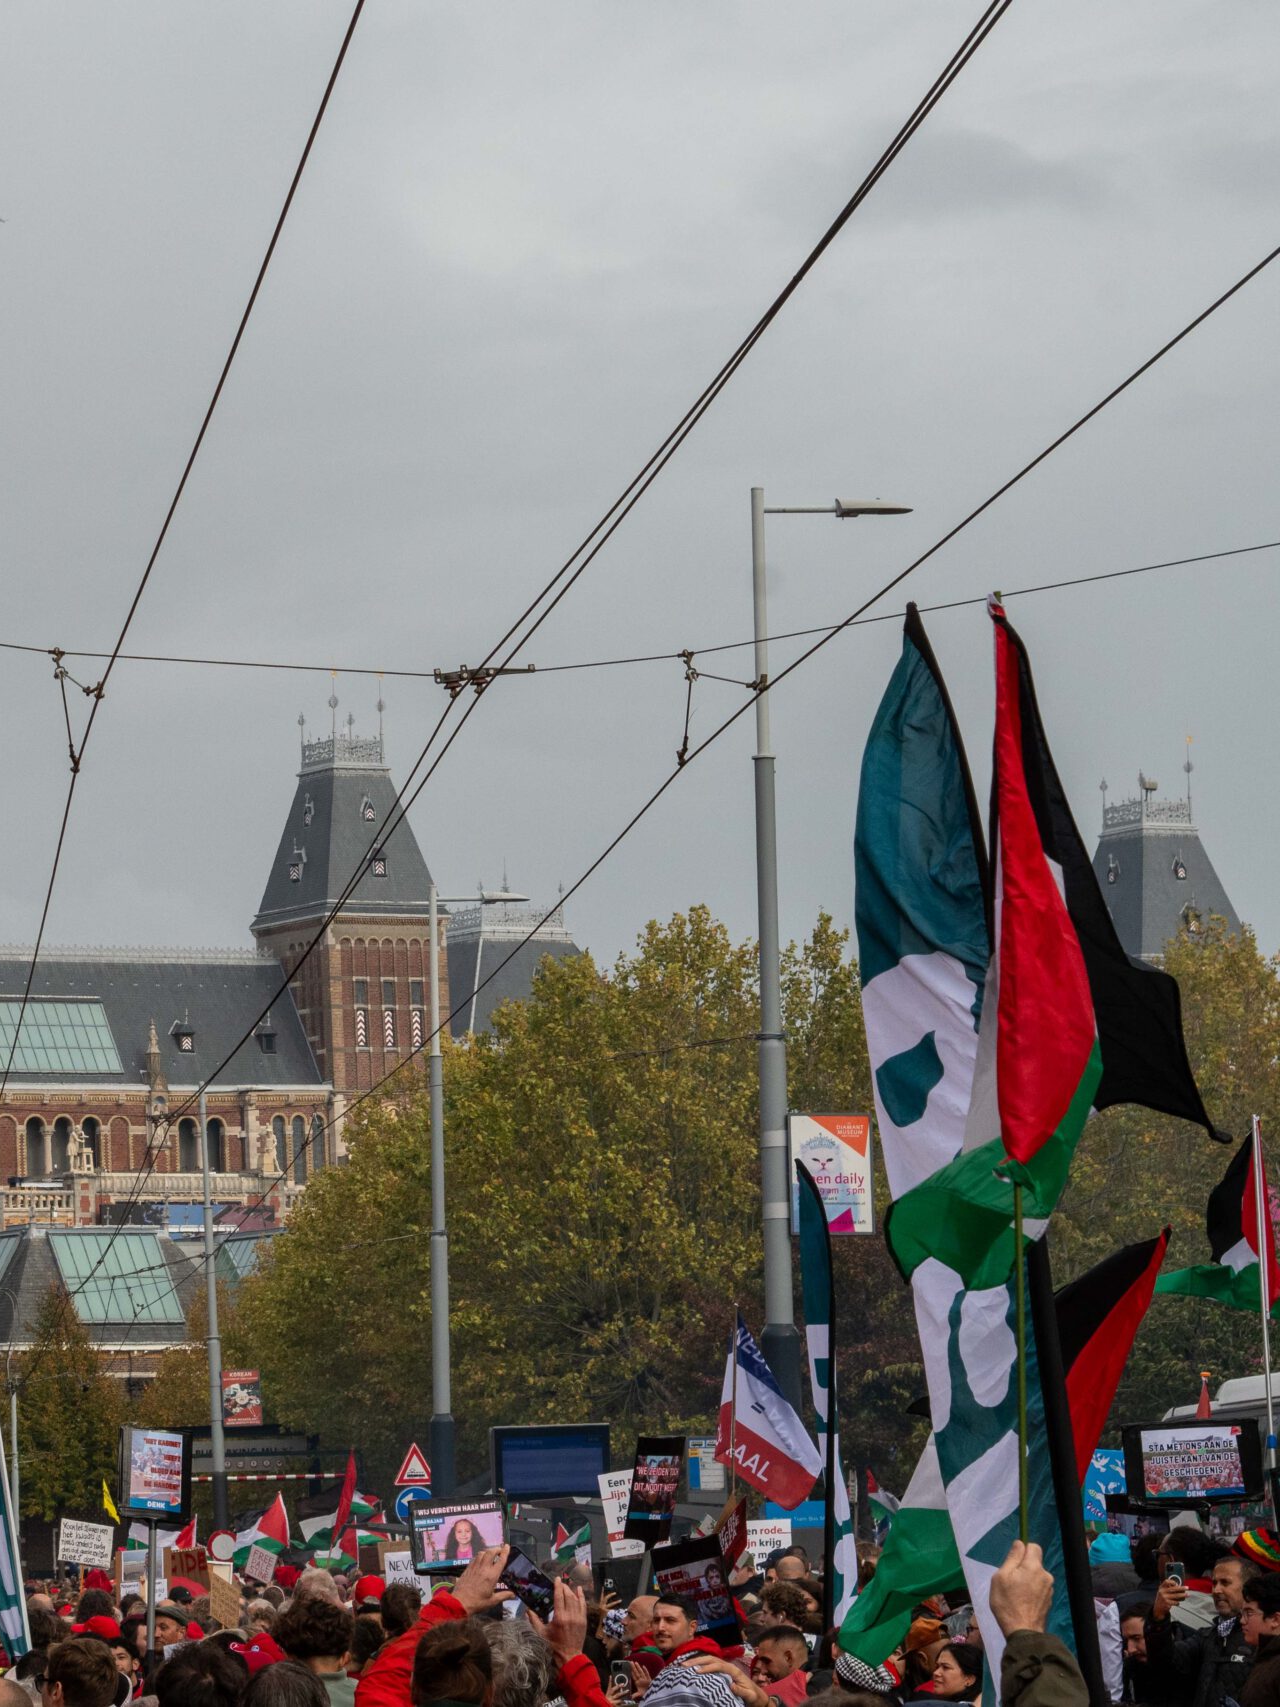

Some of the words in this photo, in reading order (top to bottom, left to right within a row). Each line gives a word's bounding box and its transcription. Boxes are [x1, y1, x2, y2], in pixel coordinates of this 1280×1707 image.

[809, 1175, 831, 1185] en
[834, 1173, 865, 1187] daily
[852, 1188, 865, 1196] pm
[1149, 1444, 1165, 1452] STA
[1167, 1442, 1183, 1451] MET
[1185, 1441, 1202, 1450] ONS
[1205, 1441, 1221, 1449] AAN
[1223, 1440, 1234, 1448] DE
[1151, 1455, 1179, 1465] JUISTE
[1181, 1454, 1203, 1464] KANT
[1205, 1453, 1221, 1462] VAN
[1224, 1452, 1235, 1461] DE
[1164, 1467, 1224, 1477] GESCHIEDENIS
[608, 1479, 625, 1488] Een
[611, 1491, 627, 1500] lijn
[147, 1501, 166, 1509] DENK
[618, 1502, 628, 1512] je
[430, 1507, 461, 1515] VERGETEN
[760, 1526, 783, 1535] rode
[759, 1538, 782, 1549] krijg
[253, 1549, 273, 1565] FREE
[252, 1560, 272, 1573] PALE
[389, 1560, 415, 1572] NEVE
[249, 1567, 270, 1582] STINE
[392, 1576, 420, 1587] AGAIN
